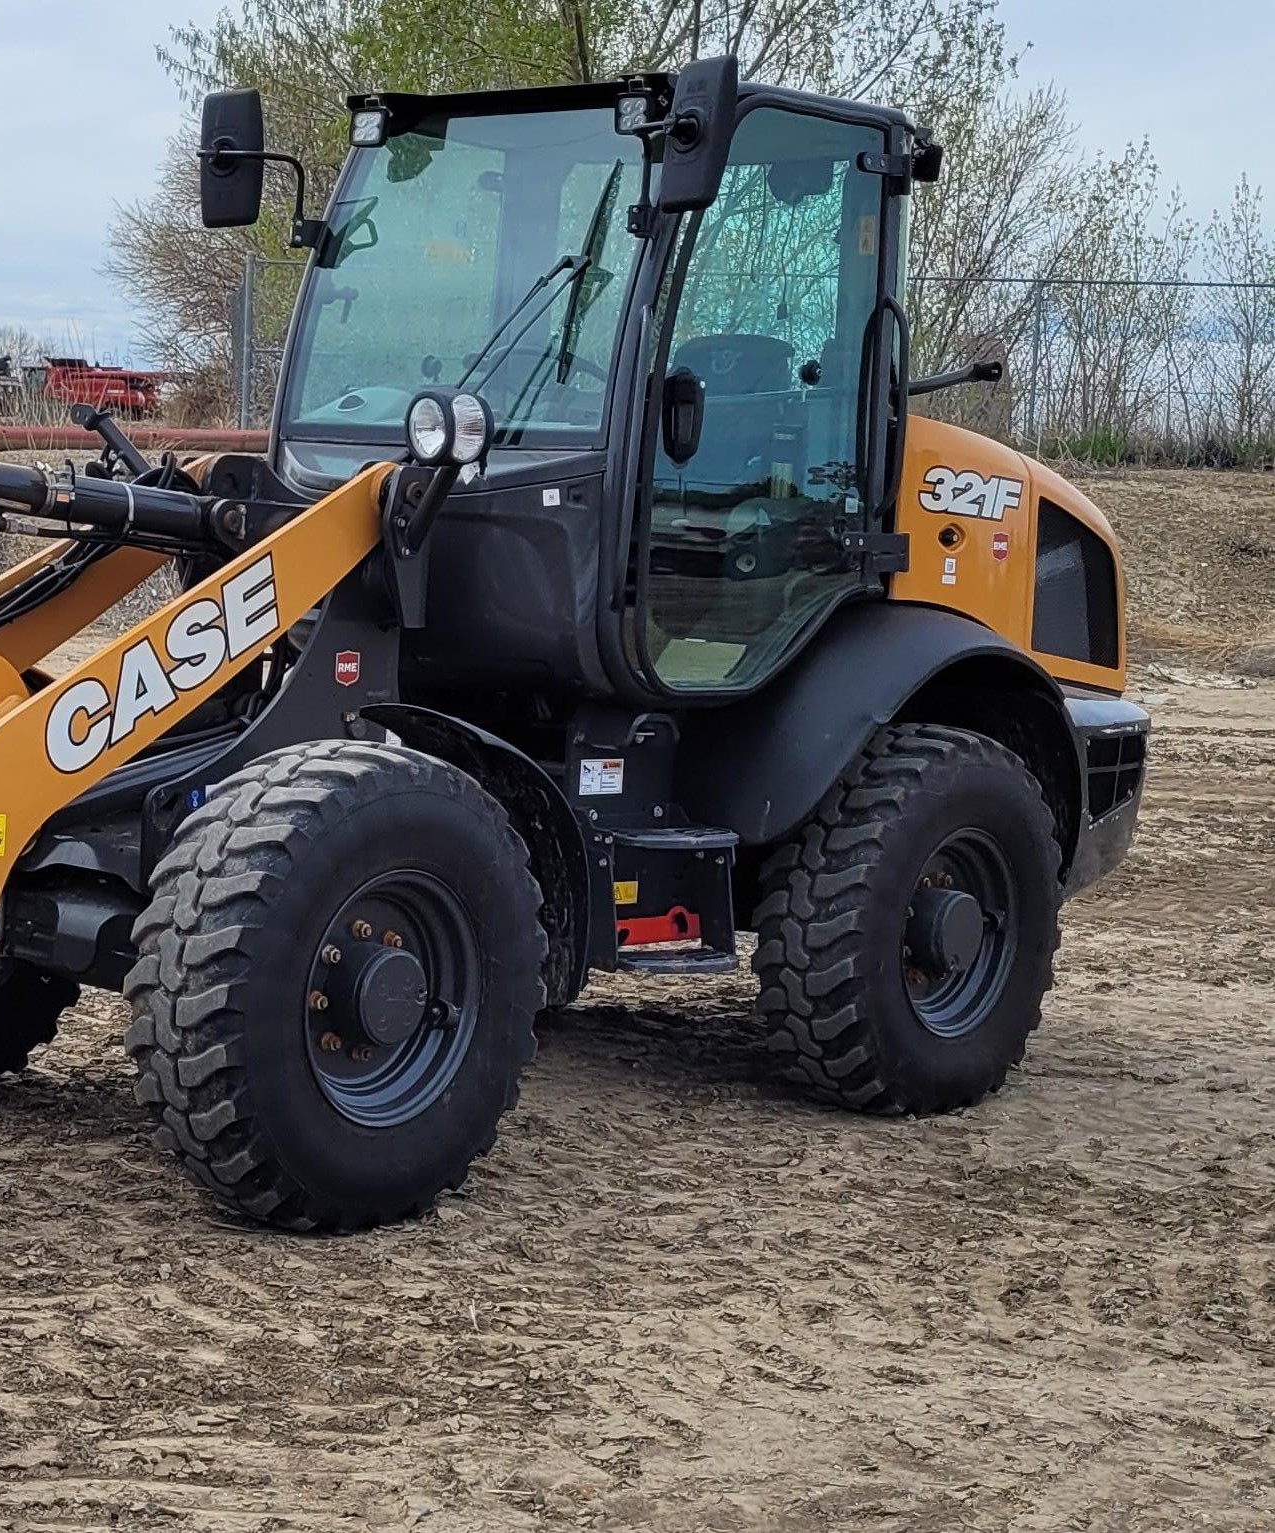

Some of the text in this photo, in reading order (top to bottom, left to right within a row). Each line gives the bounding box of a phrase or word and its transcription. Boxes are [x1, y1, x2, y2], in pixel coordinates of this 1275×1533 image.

[918, 465, 1023, 522] 321F
[45, 550, 279, 775] CASE
[338, 662, 358, 673] RME
